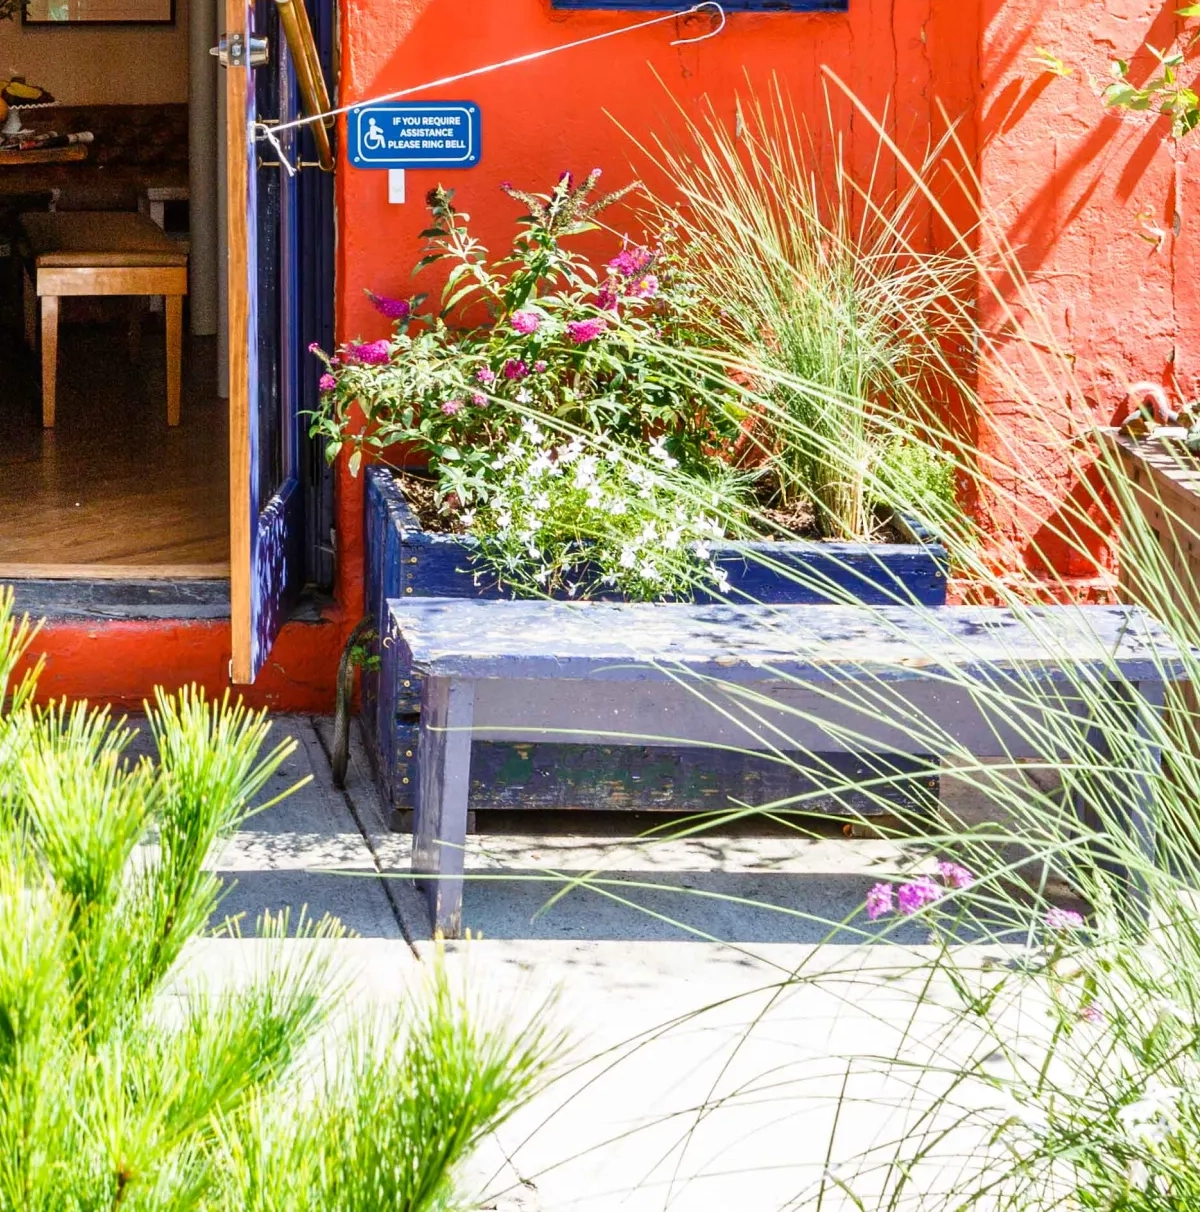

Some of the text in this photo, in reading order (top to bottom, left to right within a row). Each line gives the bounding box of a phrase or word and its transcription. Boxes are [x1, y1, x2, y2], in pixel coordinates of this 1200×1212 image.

[392, 116, 461, 126] IF YOU REQUIRE
[399, 128, 454, 137] ASSISTANCE
[387, 140, 466, 149] PLEASE RING BELL
